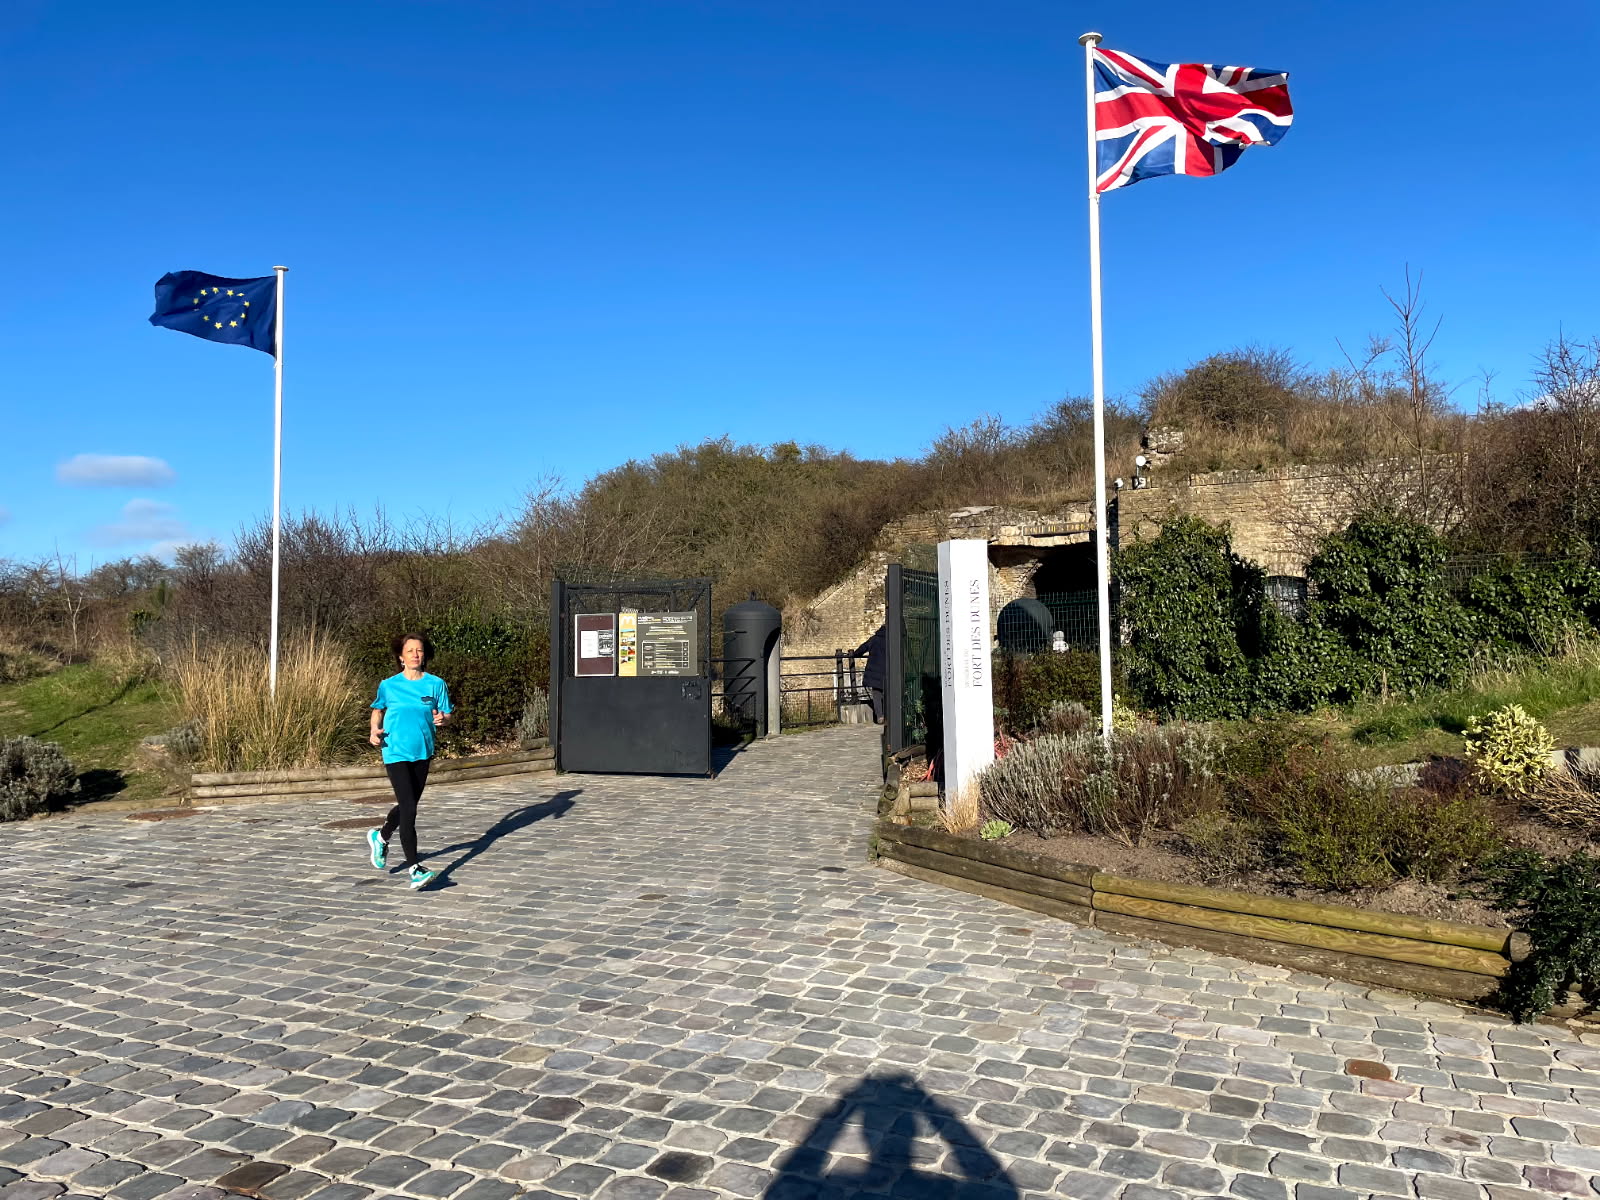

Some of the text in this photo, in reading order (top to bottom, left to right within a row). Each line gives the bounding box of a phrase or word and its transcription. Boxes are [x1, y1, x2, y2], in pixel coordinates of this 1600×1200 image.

[970, 579, 983, 687] FORT DES DUNES
